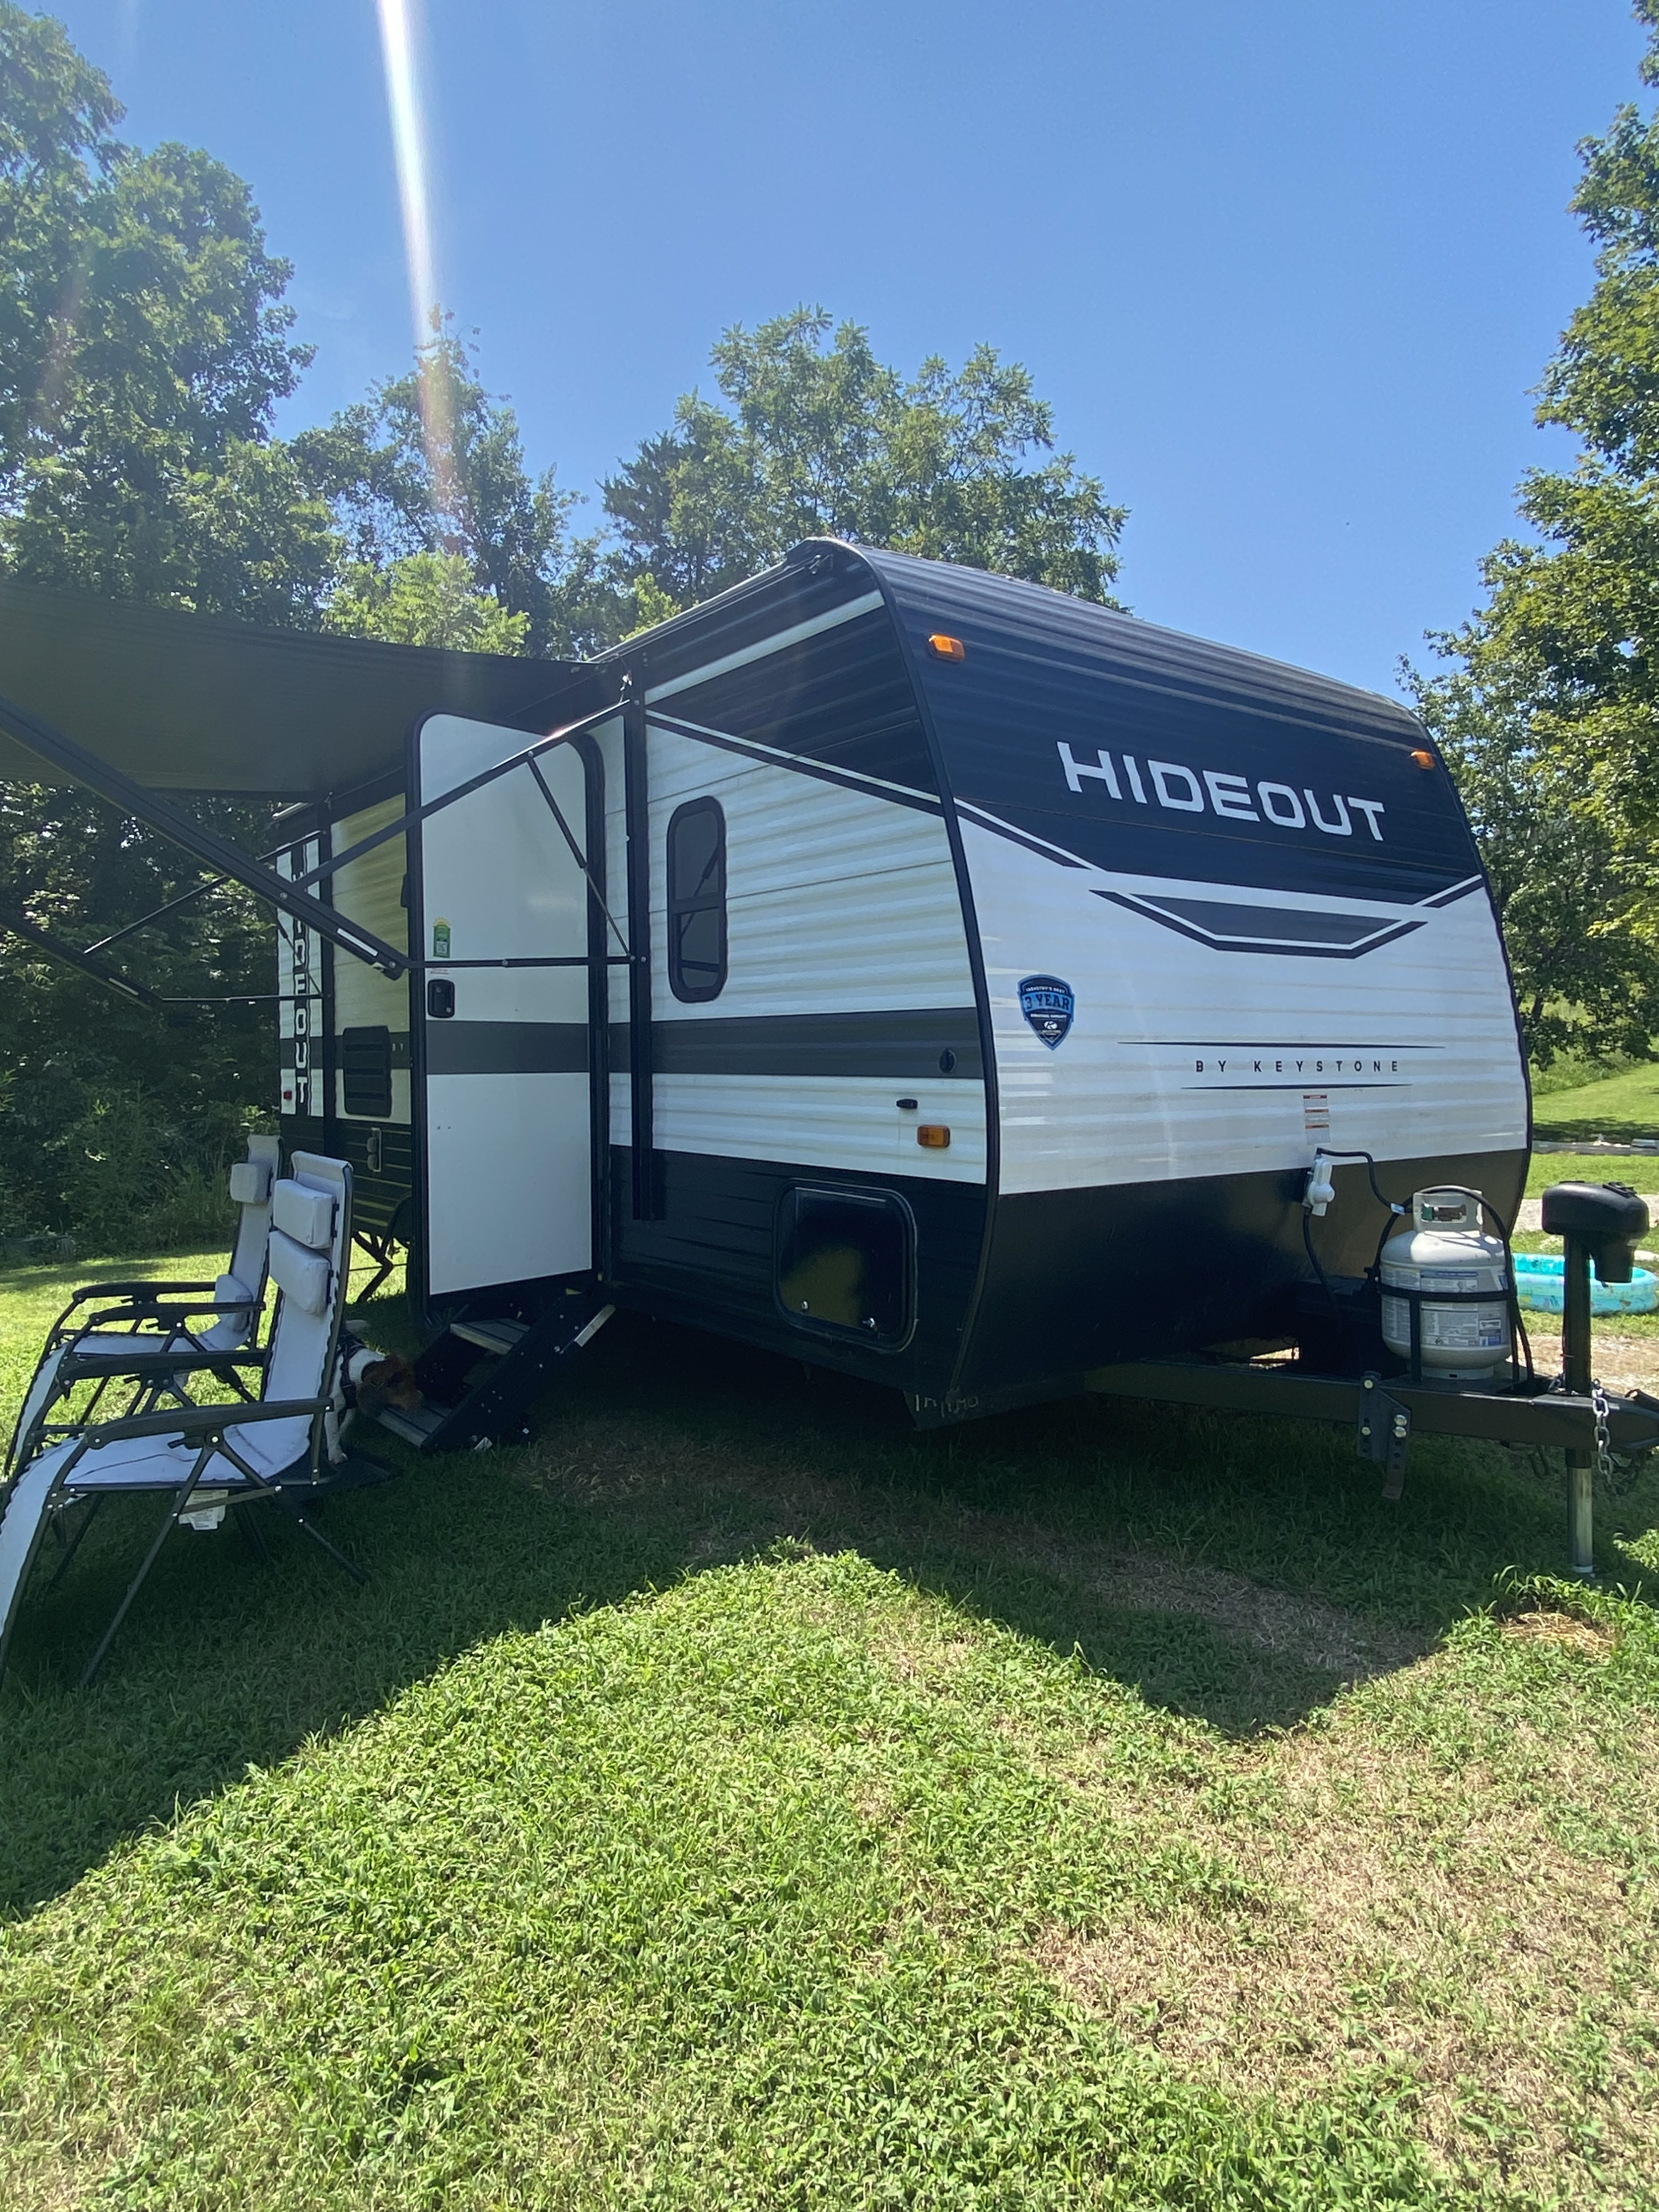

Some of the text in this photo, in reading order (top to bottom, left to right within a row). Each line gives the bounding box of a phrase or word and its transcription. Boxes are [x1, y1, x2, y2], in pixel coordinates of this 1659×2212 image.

[1057, 742, 1384, 841] HIDEOUT
[1025, 994, 1070, 1010] 3 YEAR
[1196, 1060, 1397, 1073] BY KEYSTONE
